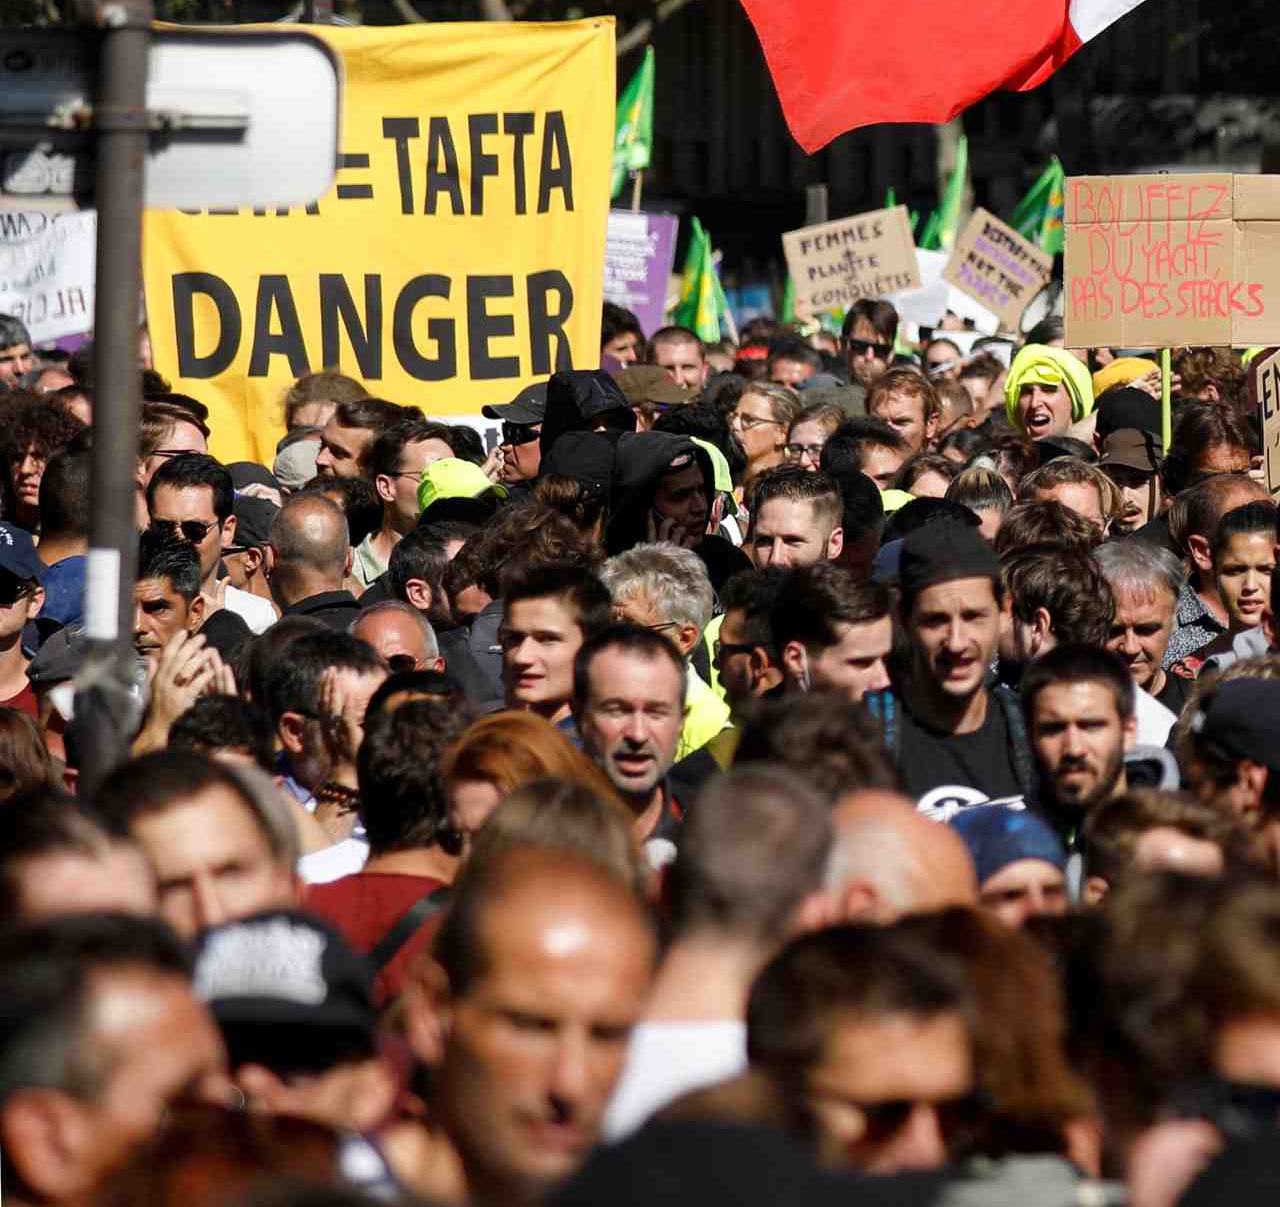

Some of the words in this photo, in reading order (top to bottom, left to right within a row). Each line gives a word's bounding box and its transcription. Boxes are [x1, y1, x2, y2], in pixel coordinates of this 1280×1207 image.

[381, 110, 575, 216] TAFTA
[799, 220, 883, 255] FEMMES
[1071, 180, 1228, 243] BOUFFEZ
[1088, 230, 1133, 281] DU
[171, 270, 575, 382] DANGER
[1071, 275, 1114, 320] PAS
[1120, 279, 1173, 318] DES
